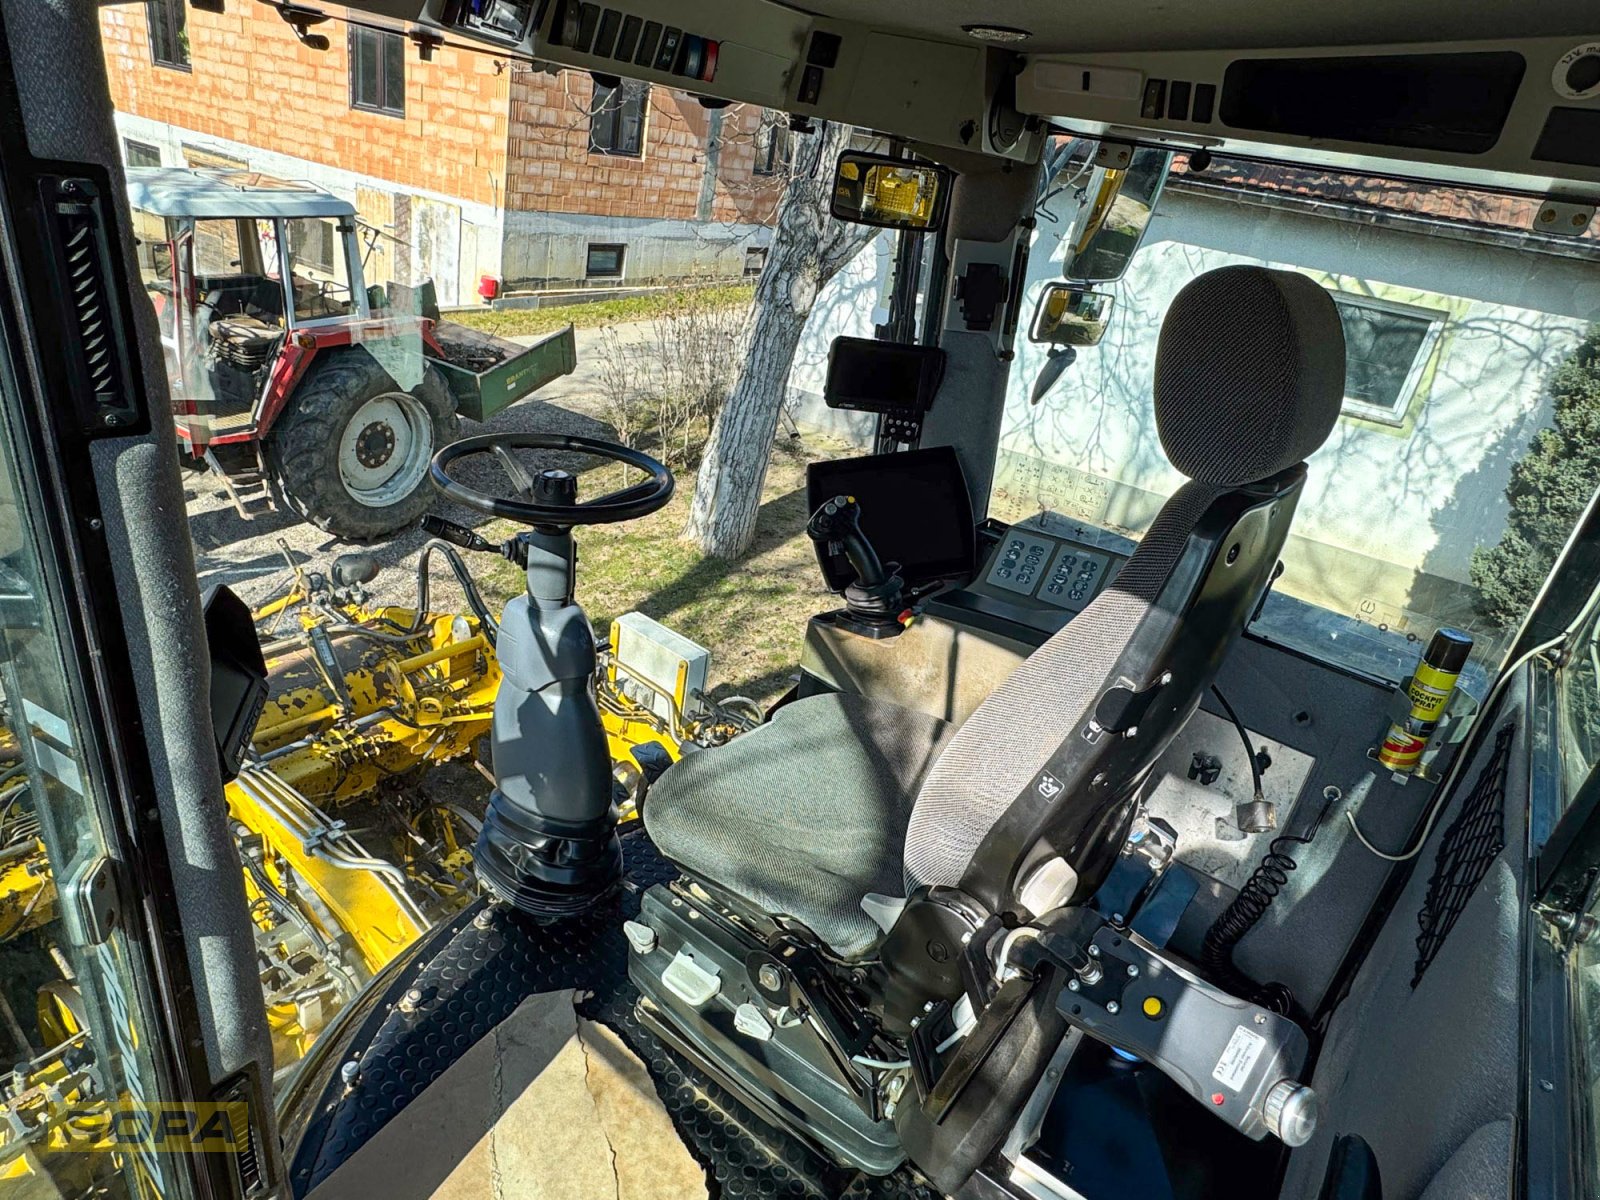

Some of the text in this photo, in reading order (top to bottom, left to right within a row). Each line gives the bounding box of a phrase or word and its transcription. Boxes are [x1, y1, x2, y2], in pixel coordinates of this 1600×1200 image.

[1411, 688, 1443, 704] COCKPIT
[1412, 695, 1436, 709] SPRAY
[97, 943, 165, 1194] concep
